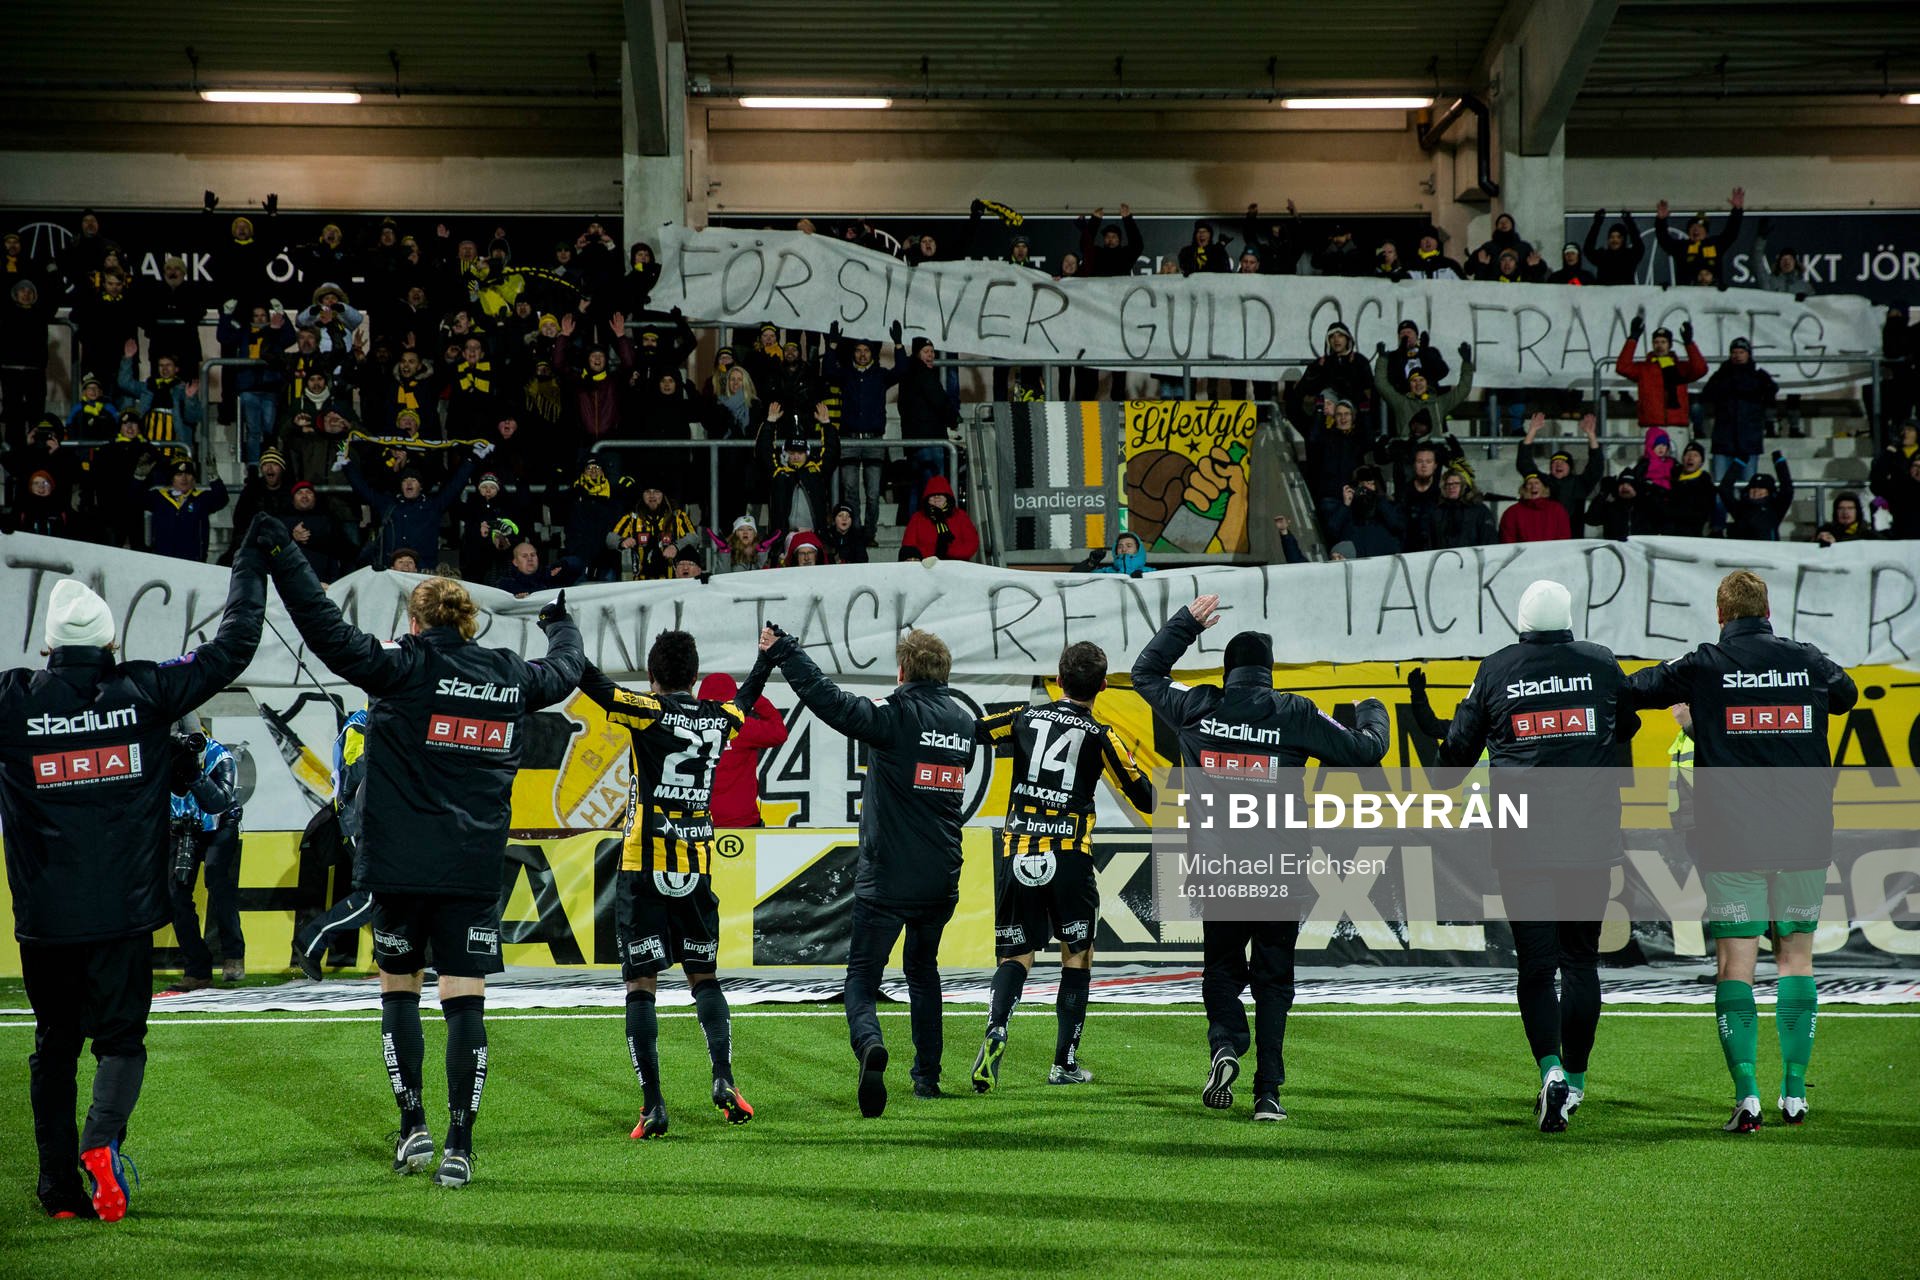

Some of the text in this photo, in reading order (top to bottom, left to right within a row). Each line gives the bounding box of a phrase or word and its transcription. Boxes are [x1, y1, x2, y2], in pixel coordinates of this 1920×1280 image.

[1732, 254, 1843, 283] SKT
[678, 239, 813, 318] FÖR
[838, 259, 1086, 360] SILVER,
[1120, 286, 1276, 361] GULD
[1131, 399, 1256, 451] Lifestyle
[1013, 492, 1105, 511] bandieras
[1506, 673, 1592, 699] stadium
[1722, 668, 1809, 688] stadium
[435, 677, 519, 703] stadium
[26, 704, 137, 736] stadium
[660, 712, 729, 731] EHRENBORG
[1024, 708, 1101, 735] EHRENBORG
[1516, 715, 1582, 731] BRA
[1732, 712, 1800, 724] BRA
[434, 721, 501, 742] BRA
[919, 729, 972, 754] stadium
[1199, 717, 1280, 745] stadium
[39, 754, 125, 777] BRA
[661, 725, 722, 789] 21
[1027, 718, 1086, 791] 14
[1204, 757, 1264, 773] BRA
[36, 772, 143, 790] BILLSTRÖM RIEMER ANDERSSON
[920, 769, 963, 784] BRA
[653, 785, 711, 802] MAXXIS
[1013, 782, 1070, 804] MAXXIS
[1026, 817, 1073, 835] bravida
[382, 1032, 399, 1067] BETONG
